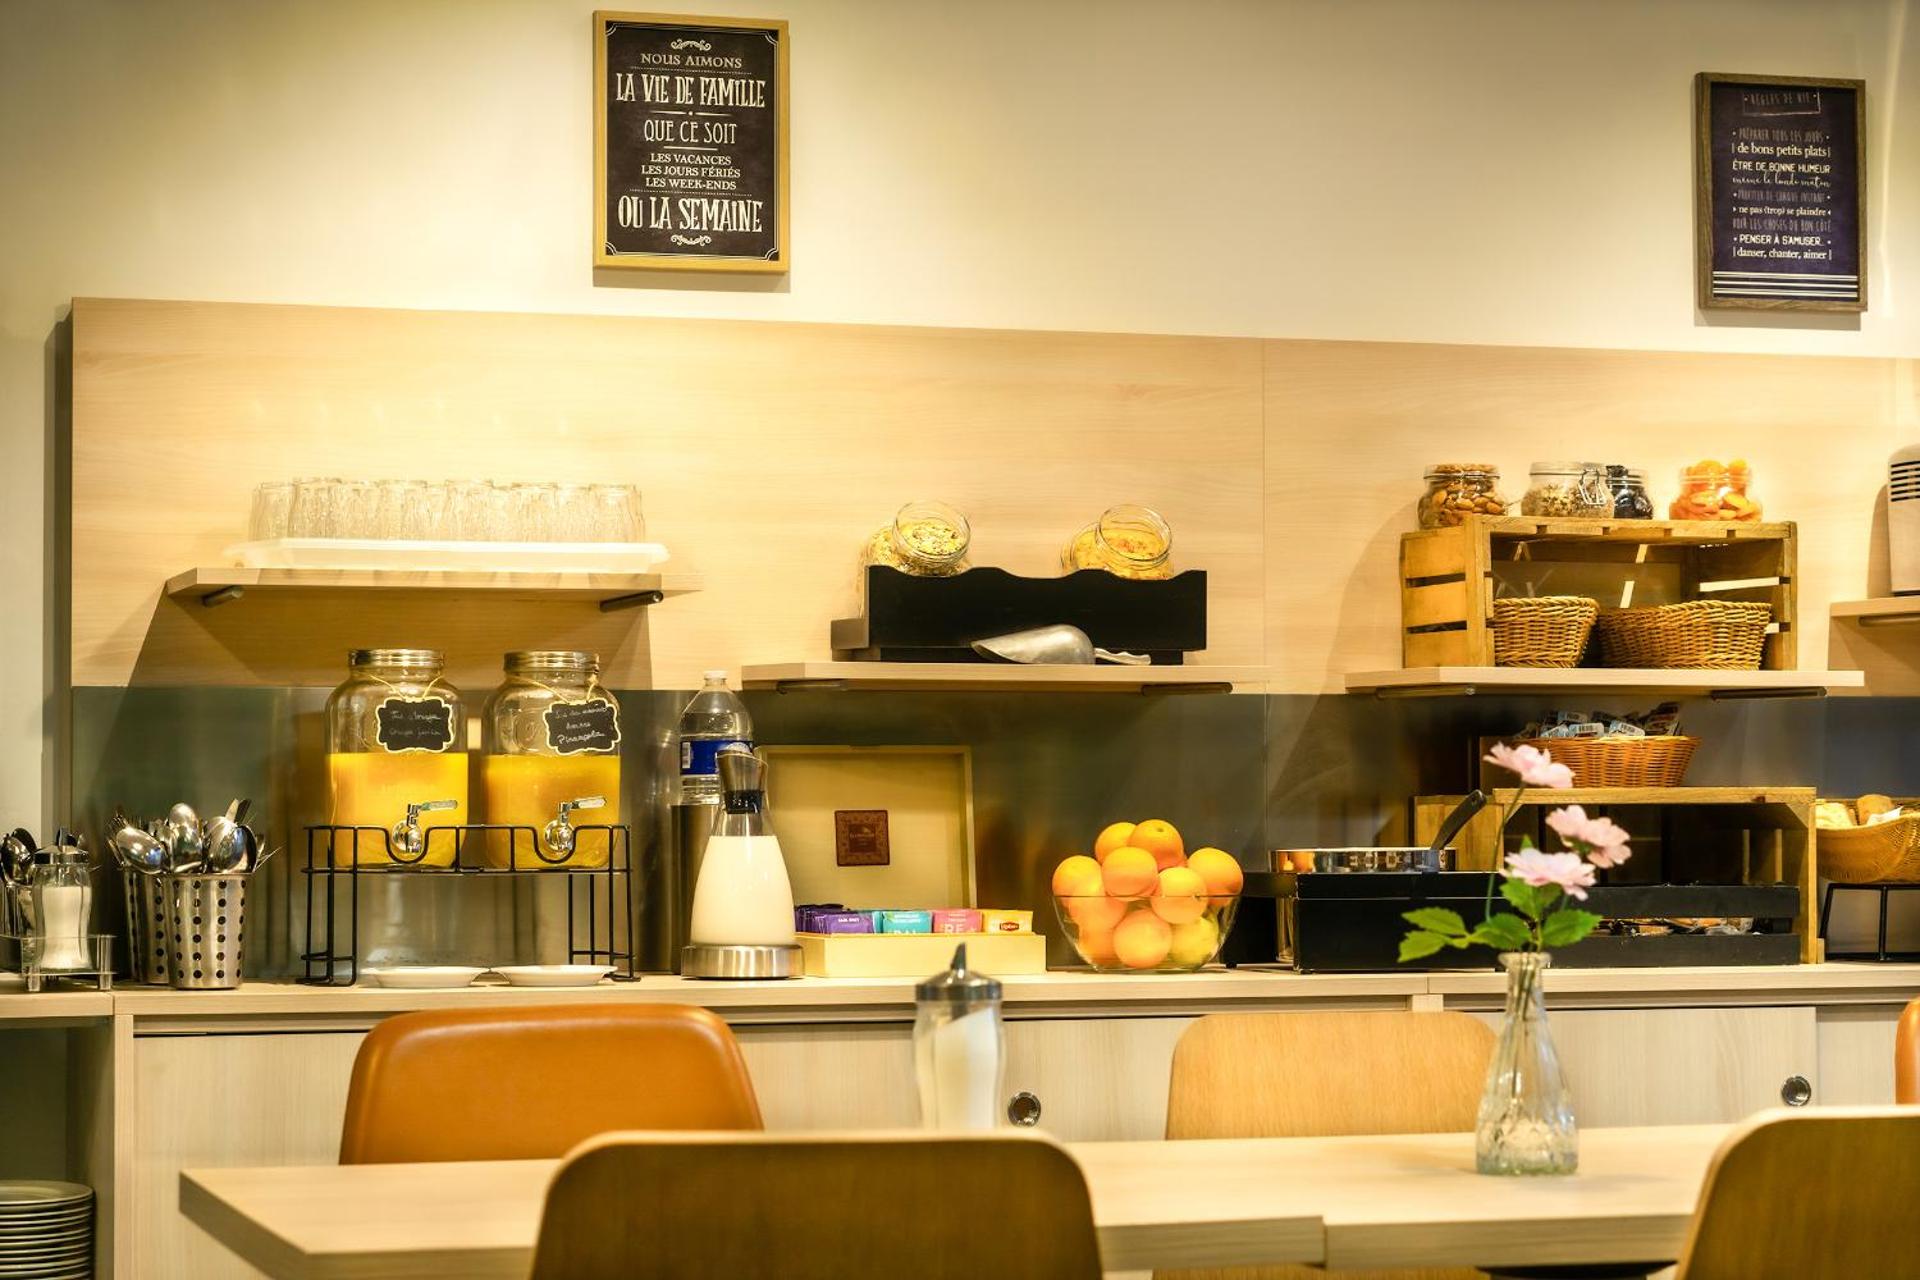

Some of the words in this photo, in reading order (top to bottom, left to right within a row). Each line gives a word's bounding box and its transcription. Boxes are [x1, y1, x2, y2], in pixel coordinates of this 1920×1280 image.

[640, 53, 680, 66] NOUS
[685, 55, 743, 69] AIMONS
[616, 73, 636, 102] LA
[675, 76, 694, 105] DE
[644, 120, 674, 142] QUE
[680, 121, 699, 142] CE
[703, 122, 737, 144] SOIT
[1737, 142, 1749, 153] de
[1751, 142, 1774, 154] bons
[1776, 144, 1803, 157] petits
[1804, 145, 1827, 158] plats
[650, 153, 672, 163] LES
[673, 154, 732, 165] VACANCES
[1732, 158, 1753, 171] ÊTRE
[1755, 161, 1766, 171] DE
[1769, 162, 1796, 172] BONNE
[1798, 163, 1831, 174] HUMEUR
[641, 165, 663, 175] LES
[663, 166, 699, 176] JOURS
[701, 165, 741, 178] FÉRIÉS
[645, 177, 667, 187] LES
[668, 178, 737, 190] WEEK-ENDS
[618, 195, 644, 229] OU
[649, 196, 673, 230] LA
[1750, 207, 1763, 215] pas
[1764, 206, 1785, 216] (trop)
[1796, 207, 1826, 217] plaindre
[1739, 233, 1772, 244] PENSER
[1773, 232, 1780, 245] À
[1737, 247, 1767, 258] danser,
[1769, 248, 1801, 259] chanter,
[1803, 249, 1827, 259] aimer
